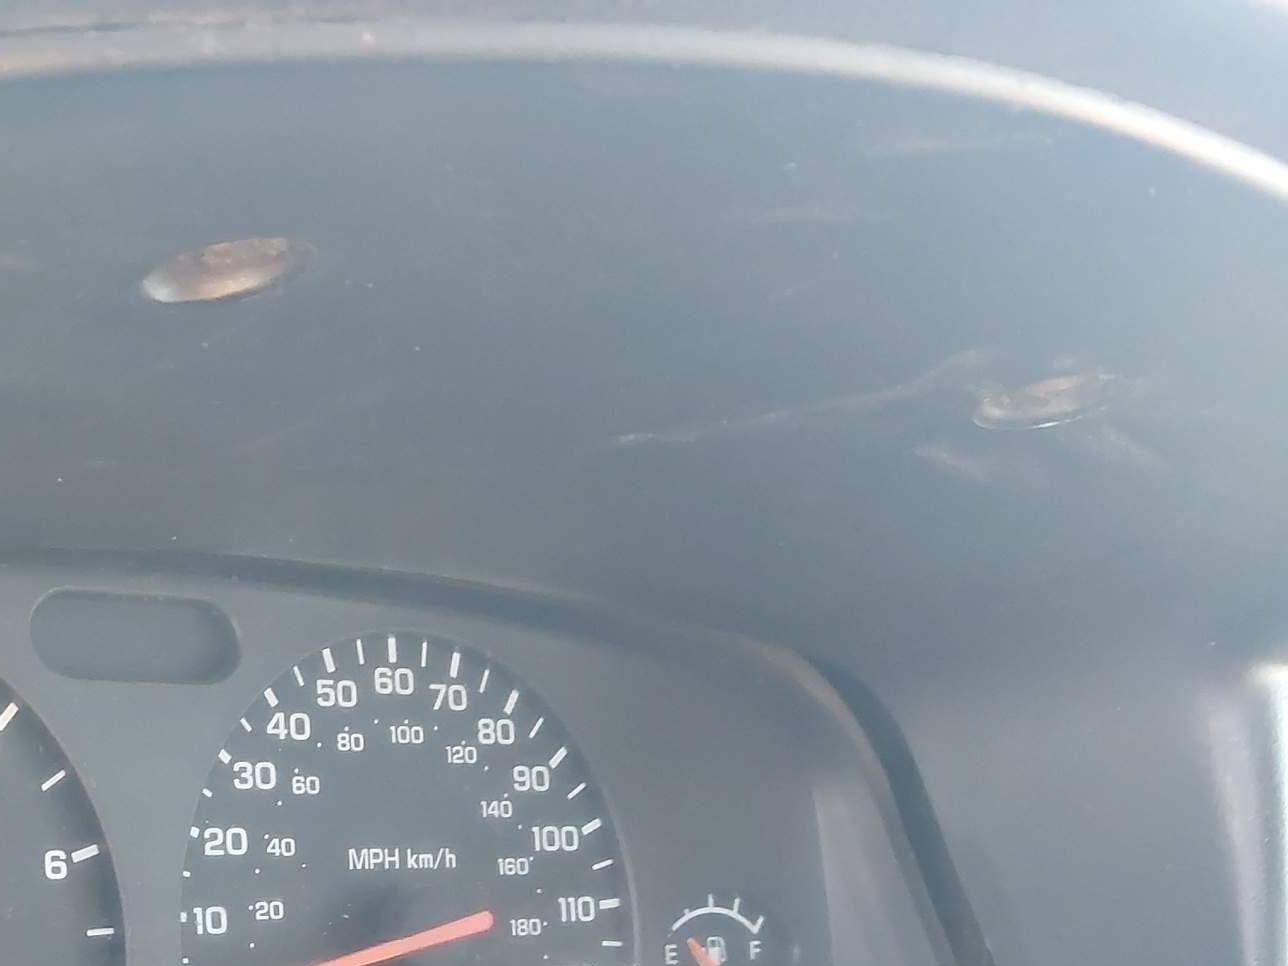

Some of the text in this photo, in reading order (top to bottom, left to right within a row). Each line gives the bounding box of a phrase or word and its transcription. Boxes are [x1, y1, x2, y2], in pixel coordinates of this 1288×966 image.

[373, 667, 414, 695] 60
[316, 680, 358, 708] 50
[429, 684, 468, 712] 70
[266, 713, 311, 741] 40
[389, 725, 424, 744] 100
[477, 719, 515, 745] 80
[336, 732, 364, 752] 80
[445, 745, 477, 765] 120
[232, 762, 277, 791] 30
[291, 775, 320, 795] 60
[513, 766, 550, 792] 90
[480, 800, 512, 819] 140
[203, 827, 248, 856] 20
[266, 836, 296, 857] 40
[531, 825, 578, 852] 100
[44, 850, 68, 880] 6
[348, 847, 457, 871] MPH km/h
[497, 856, 529, 876] 160
[192, 906, 227, 935] 10
[254, 900, 284, 921] 20
[558, 896, 595, 922] 110
[509, 918, 541, 936] 180
[664, 944, 679, 965] E
[749, 941, 762, 960] F
